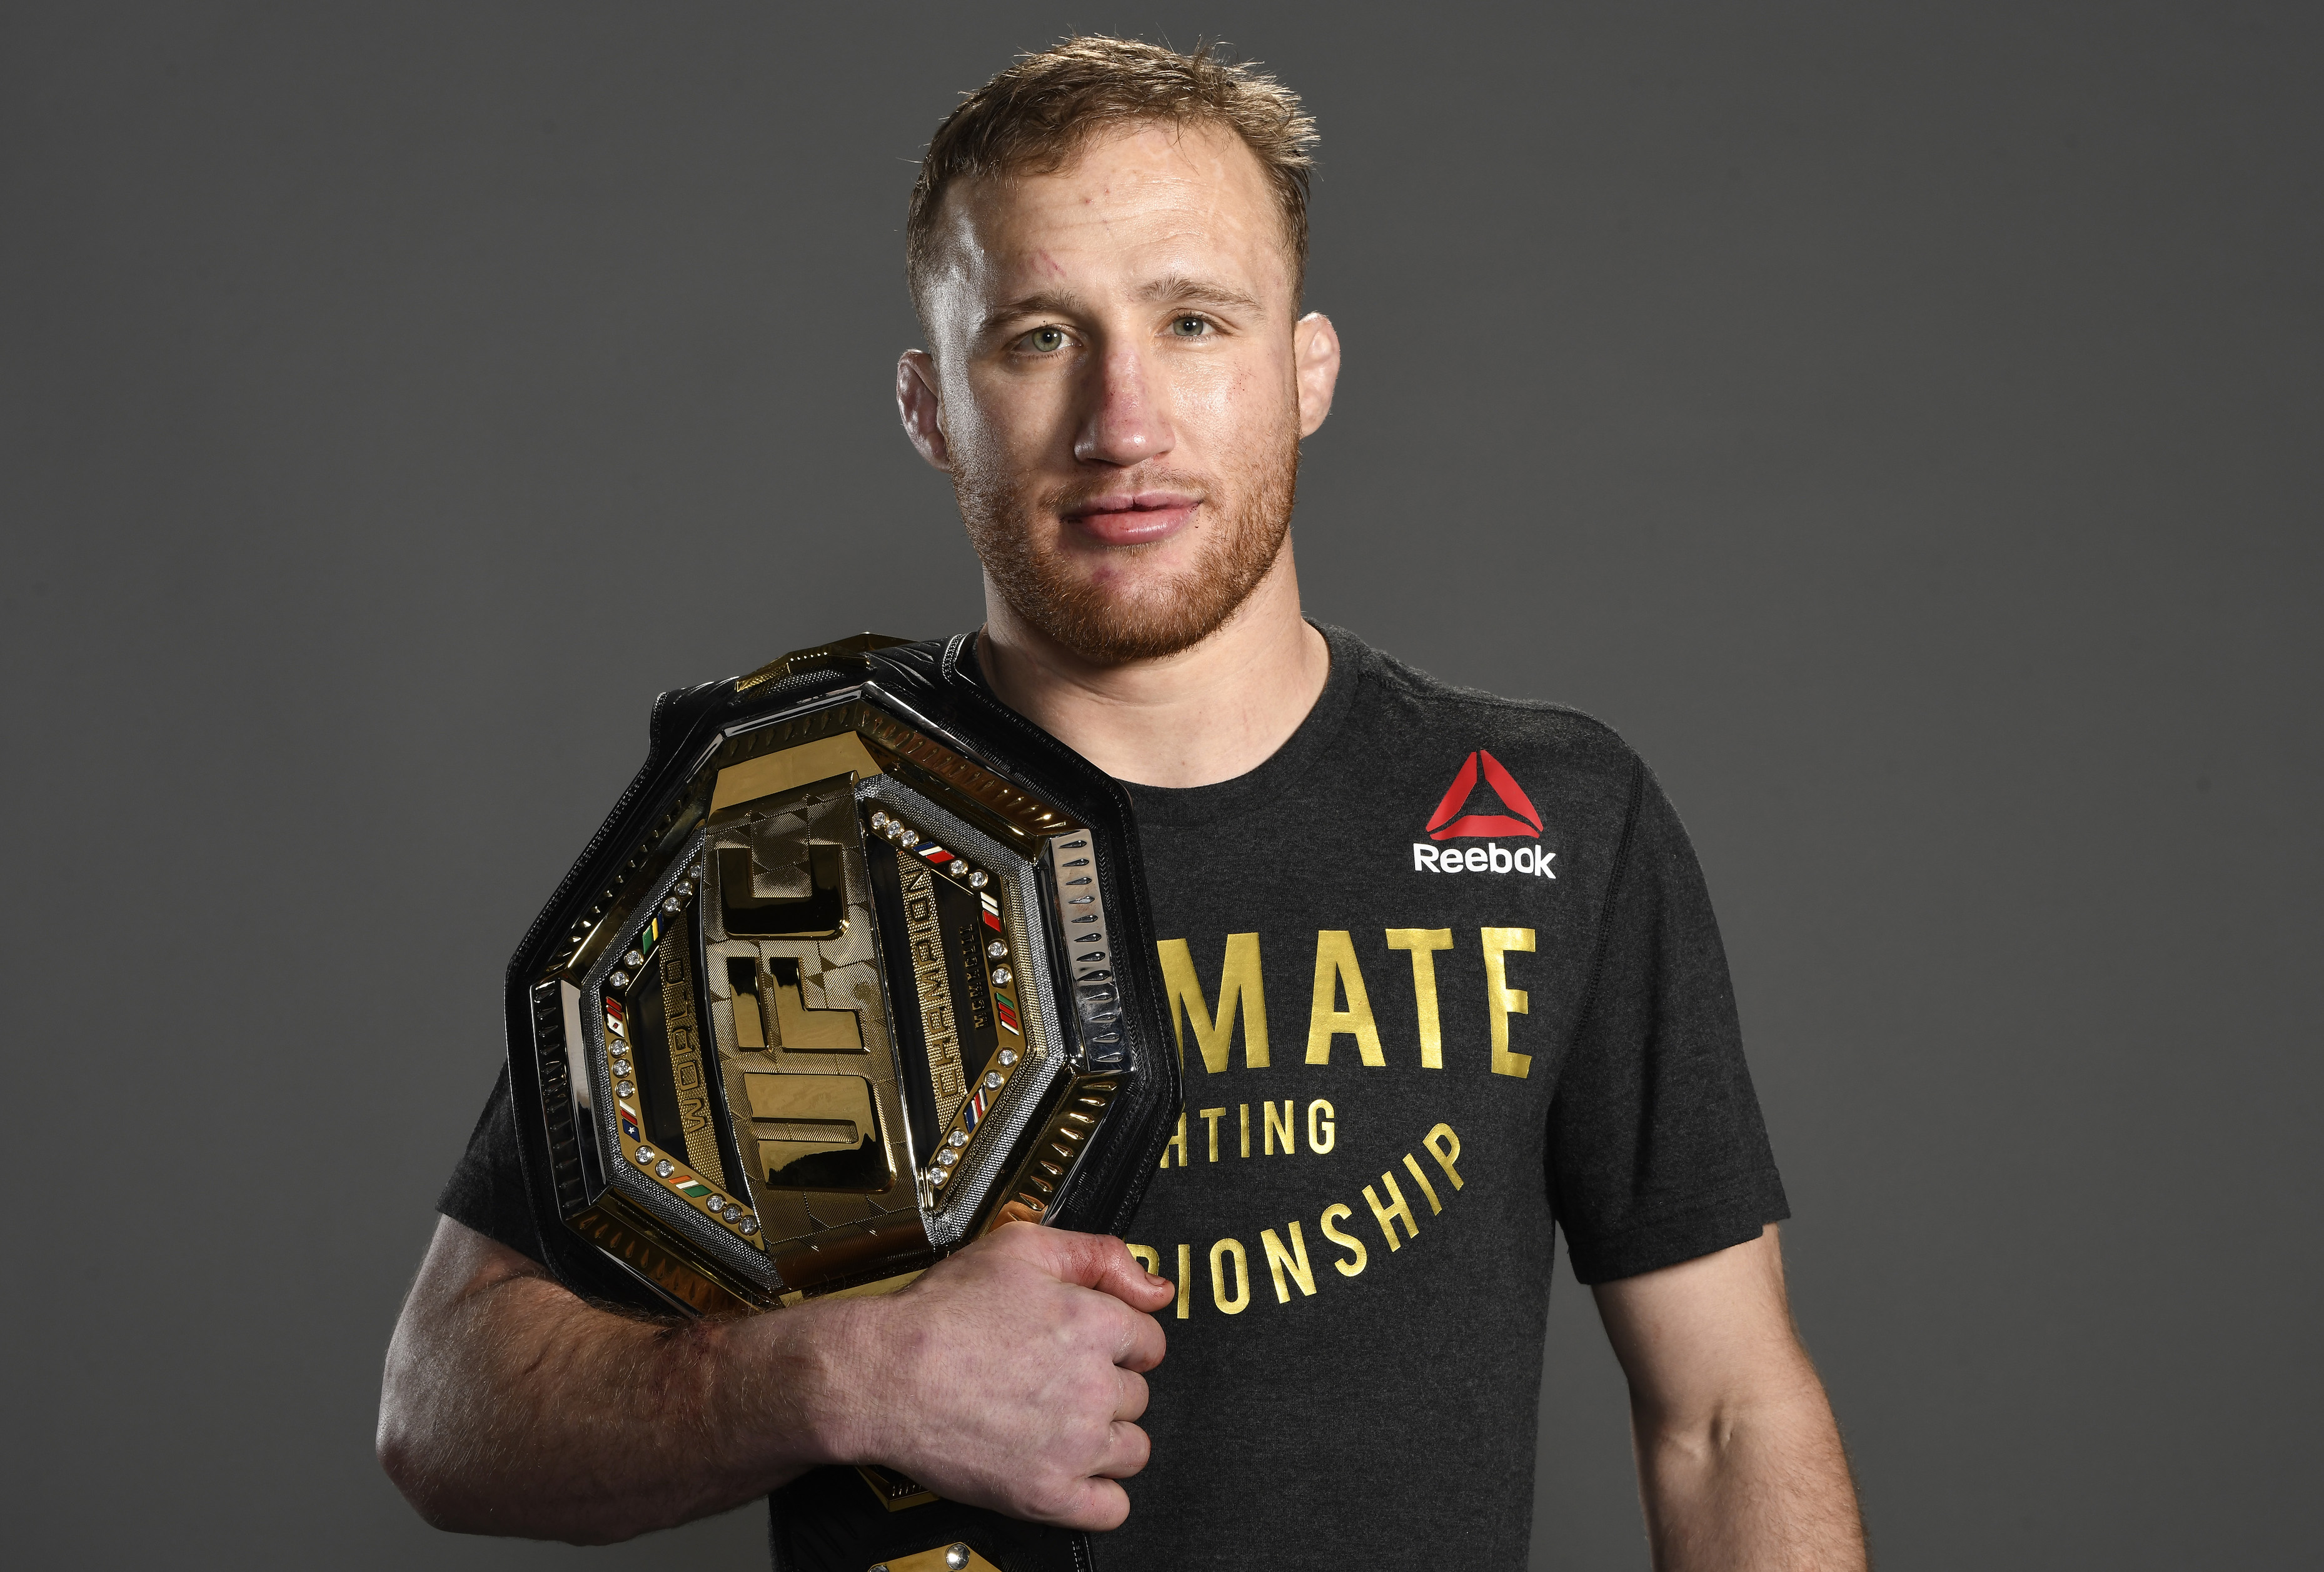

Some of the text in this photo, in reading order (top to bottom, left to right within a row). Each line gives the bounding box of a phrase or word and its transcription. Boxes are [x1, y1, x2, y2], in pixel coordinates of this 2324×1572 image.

[1414, 843, 1556, 879] Reebok
[665, 959, 707, 1133] WORLD
[715, 842, 898, 1193] UFC
[905, 868, 959, 1097] CHAMPION
[1157, 927, 1536, 1078] MATE
